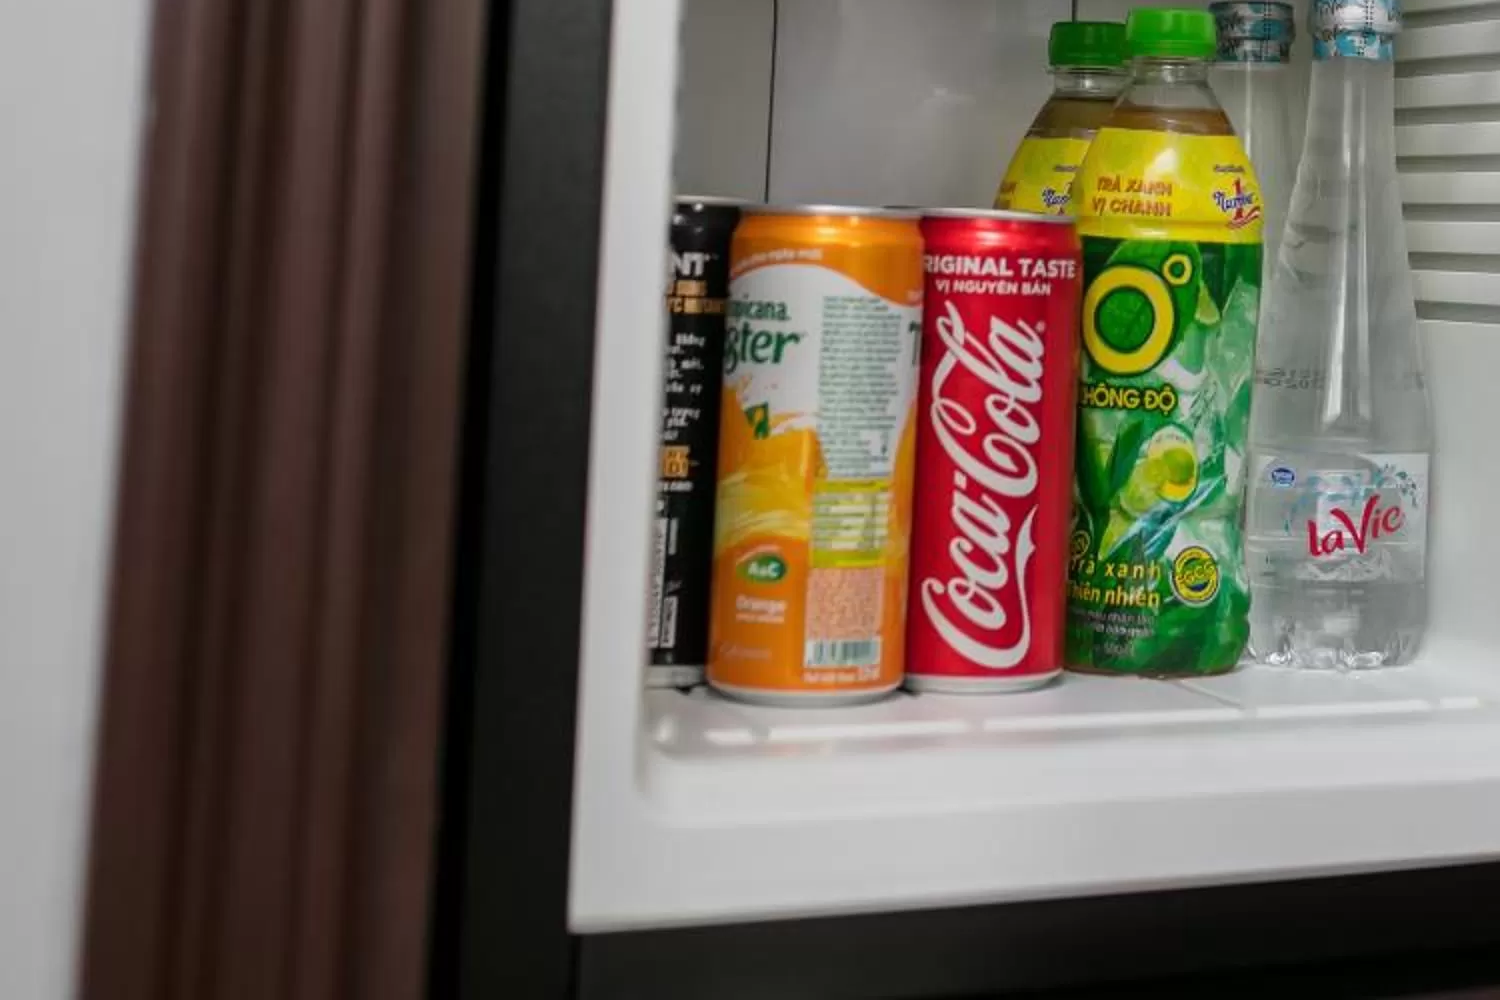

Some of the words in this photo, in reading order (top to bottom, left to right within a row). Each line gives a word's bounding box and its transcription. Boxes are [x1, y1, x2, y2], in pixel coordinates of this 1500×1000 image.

[1017, 258, 1077, 279] TASTE
[921, 299, 1046, 669] Coca-Cola
[1104, 560, 1162, 580] xanh
